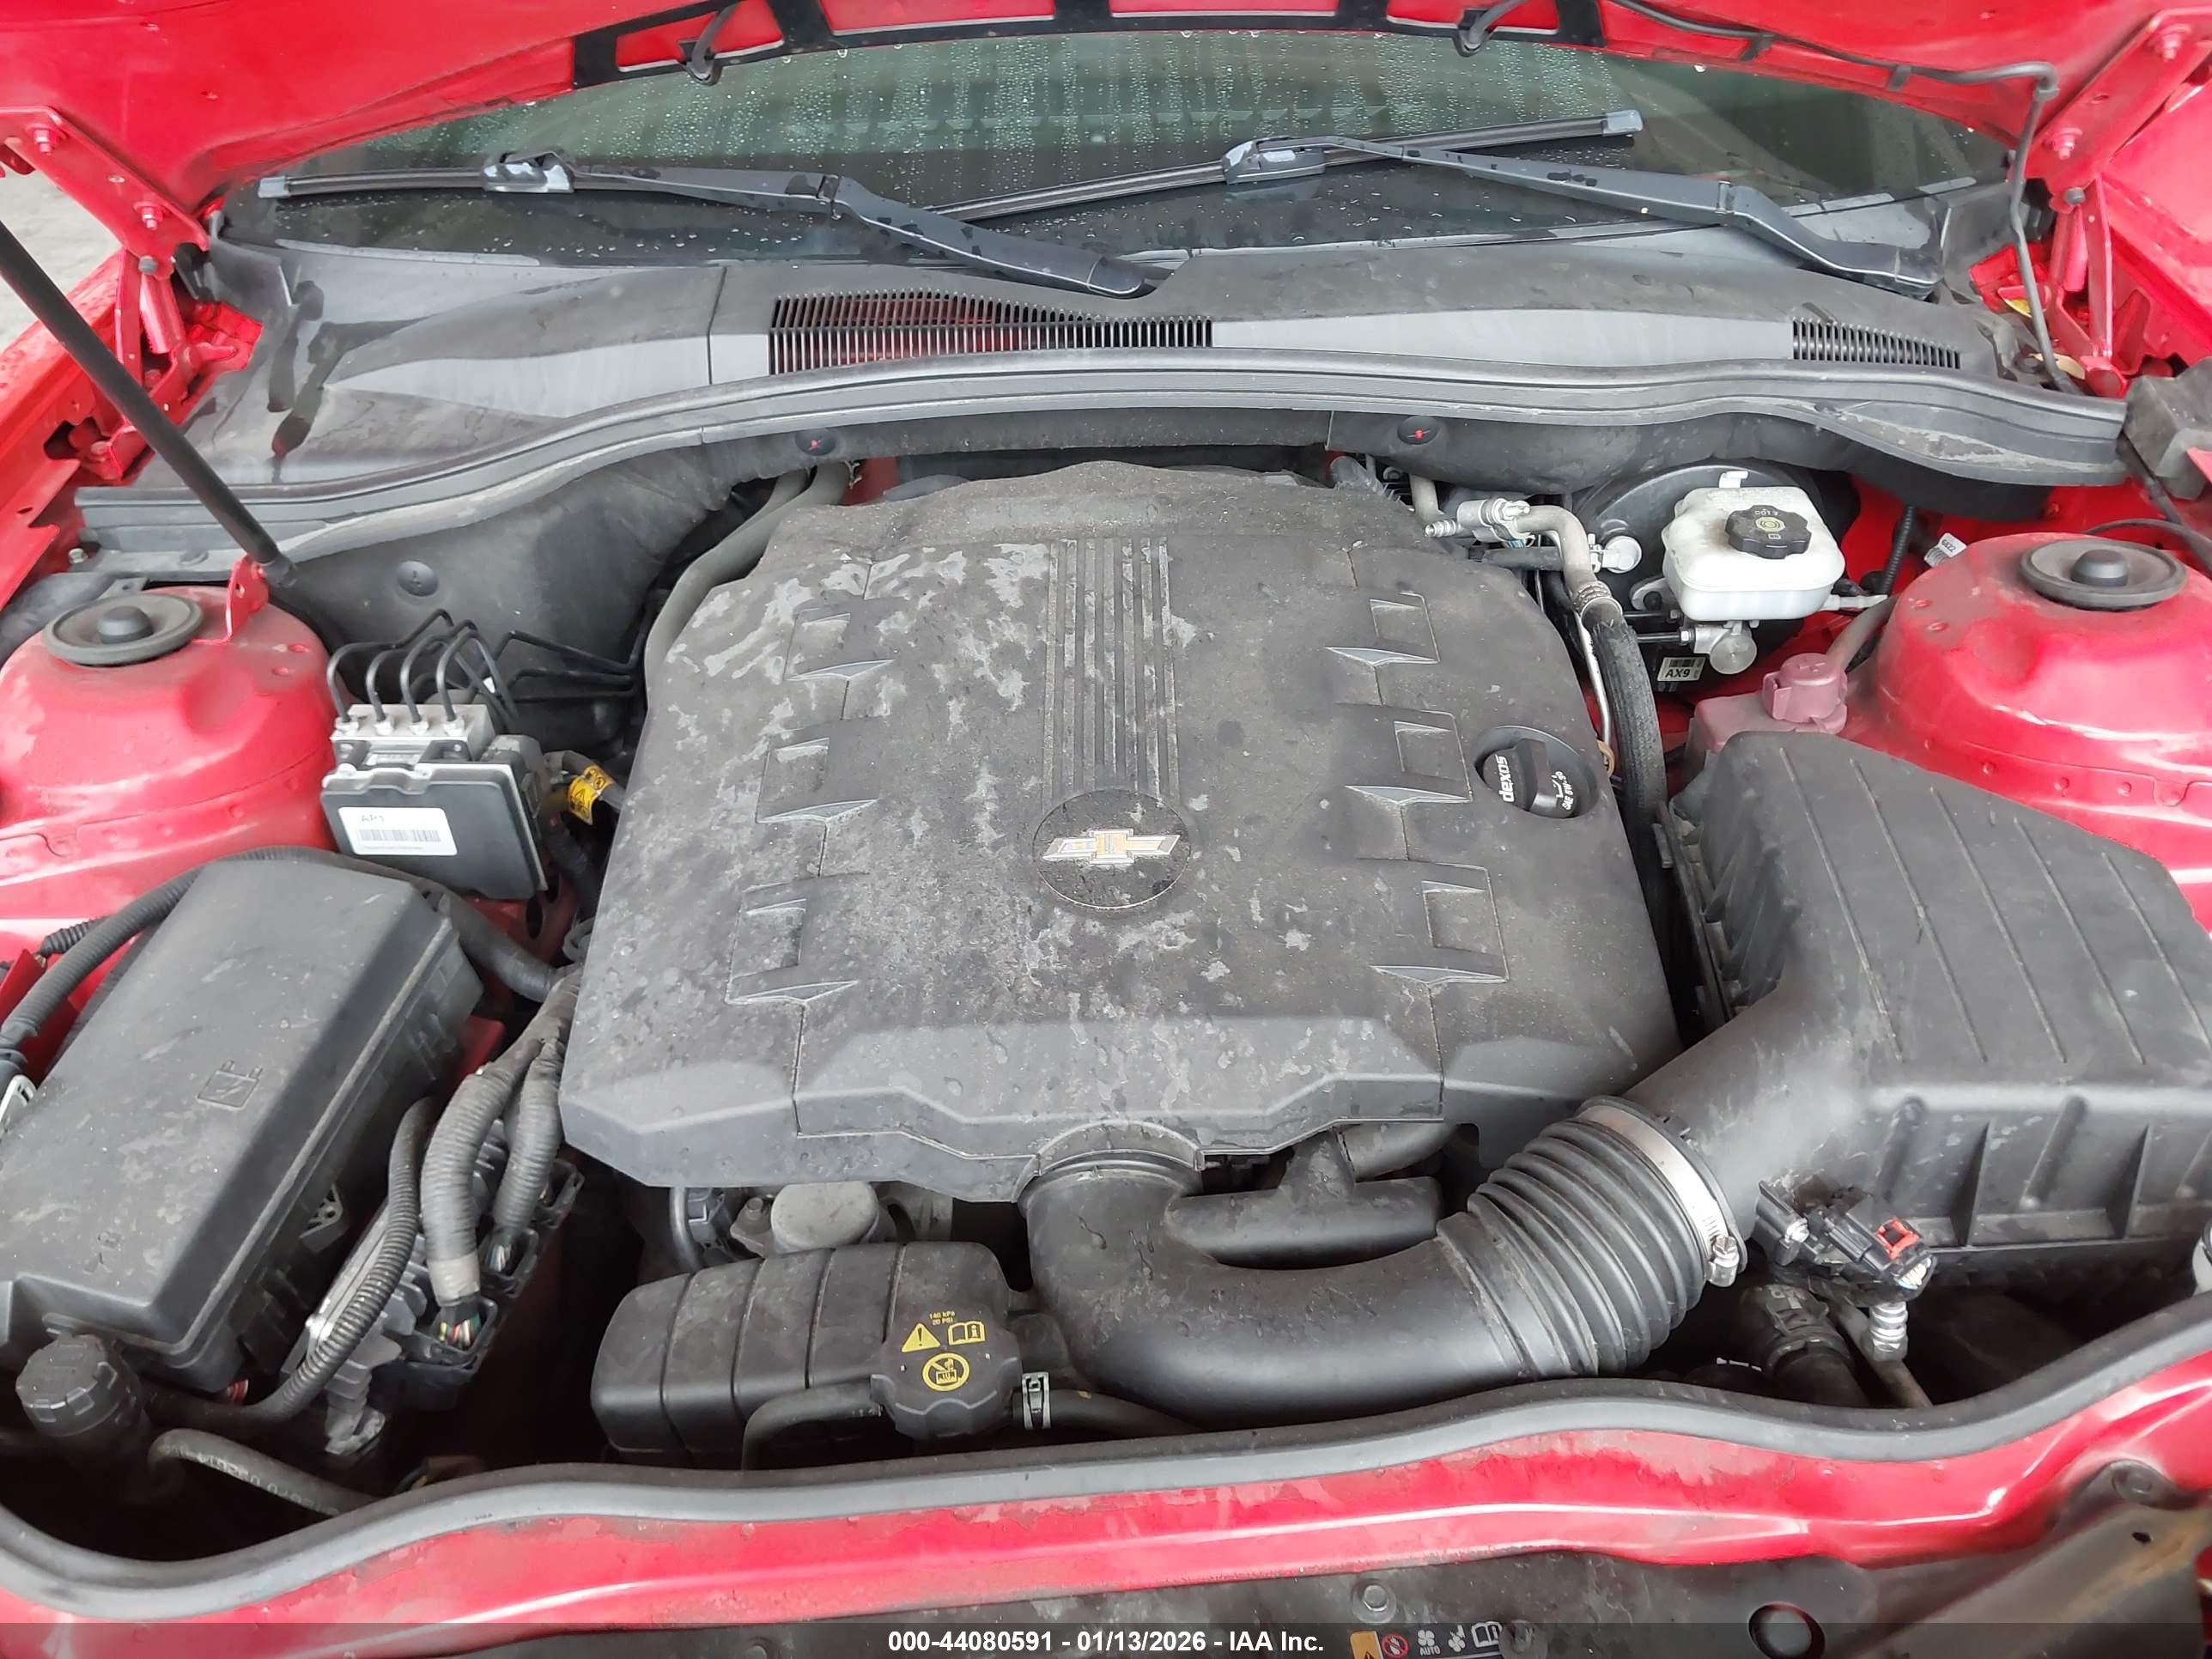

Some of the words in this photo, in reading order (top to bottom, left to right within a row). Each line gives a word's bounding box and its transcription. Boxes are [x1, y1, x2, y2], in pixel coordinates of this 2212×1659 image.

[1664, 668, 1691, 678] AX9
[1494, 754, 1515, 803] dexos
[1562, 795, 1574, 811] SAE
[929, 1311, 942, 1320] 140
[1419, 1644, 1441, 1656] AUTO
